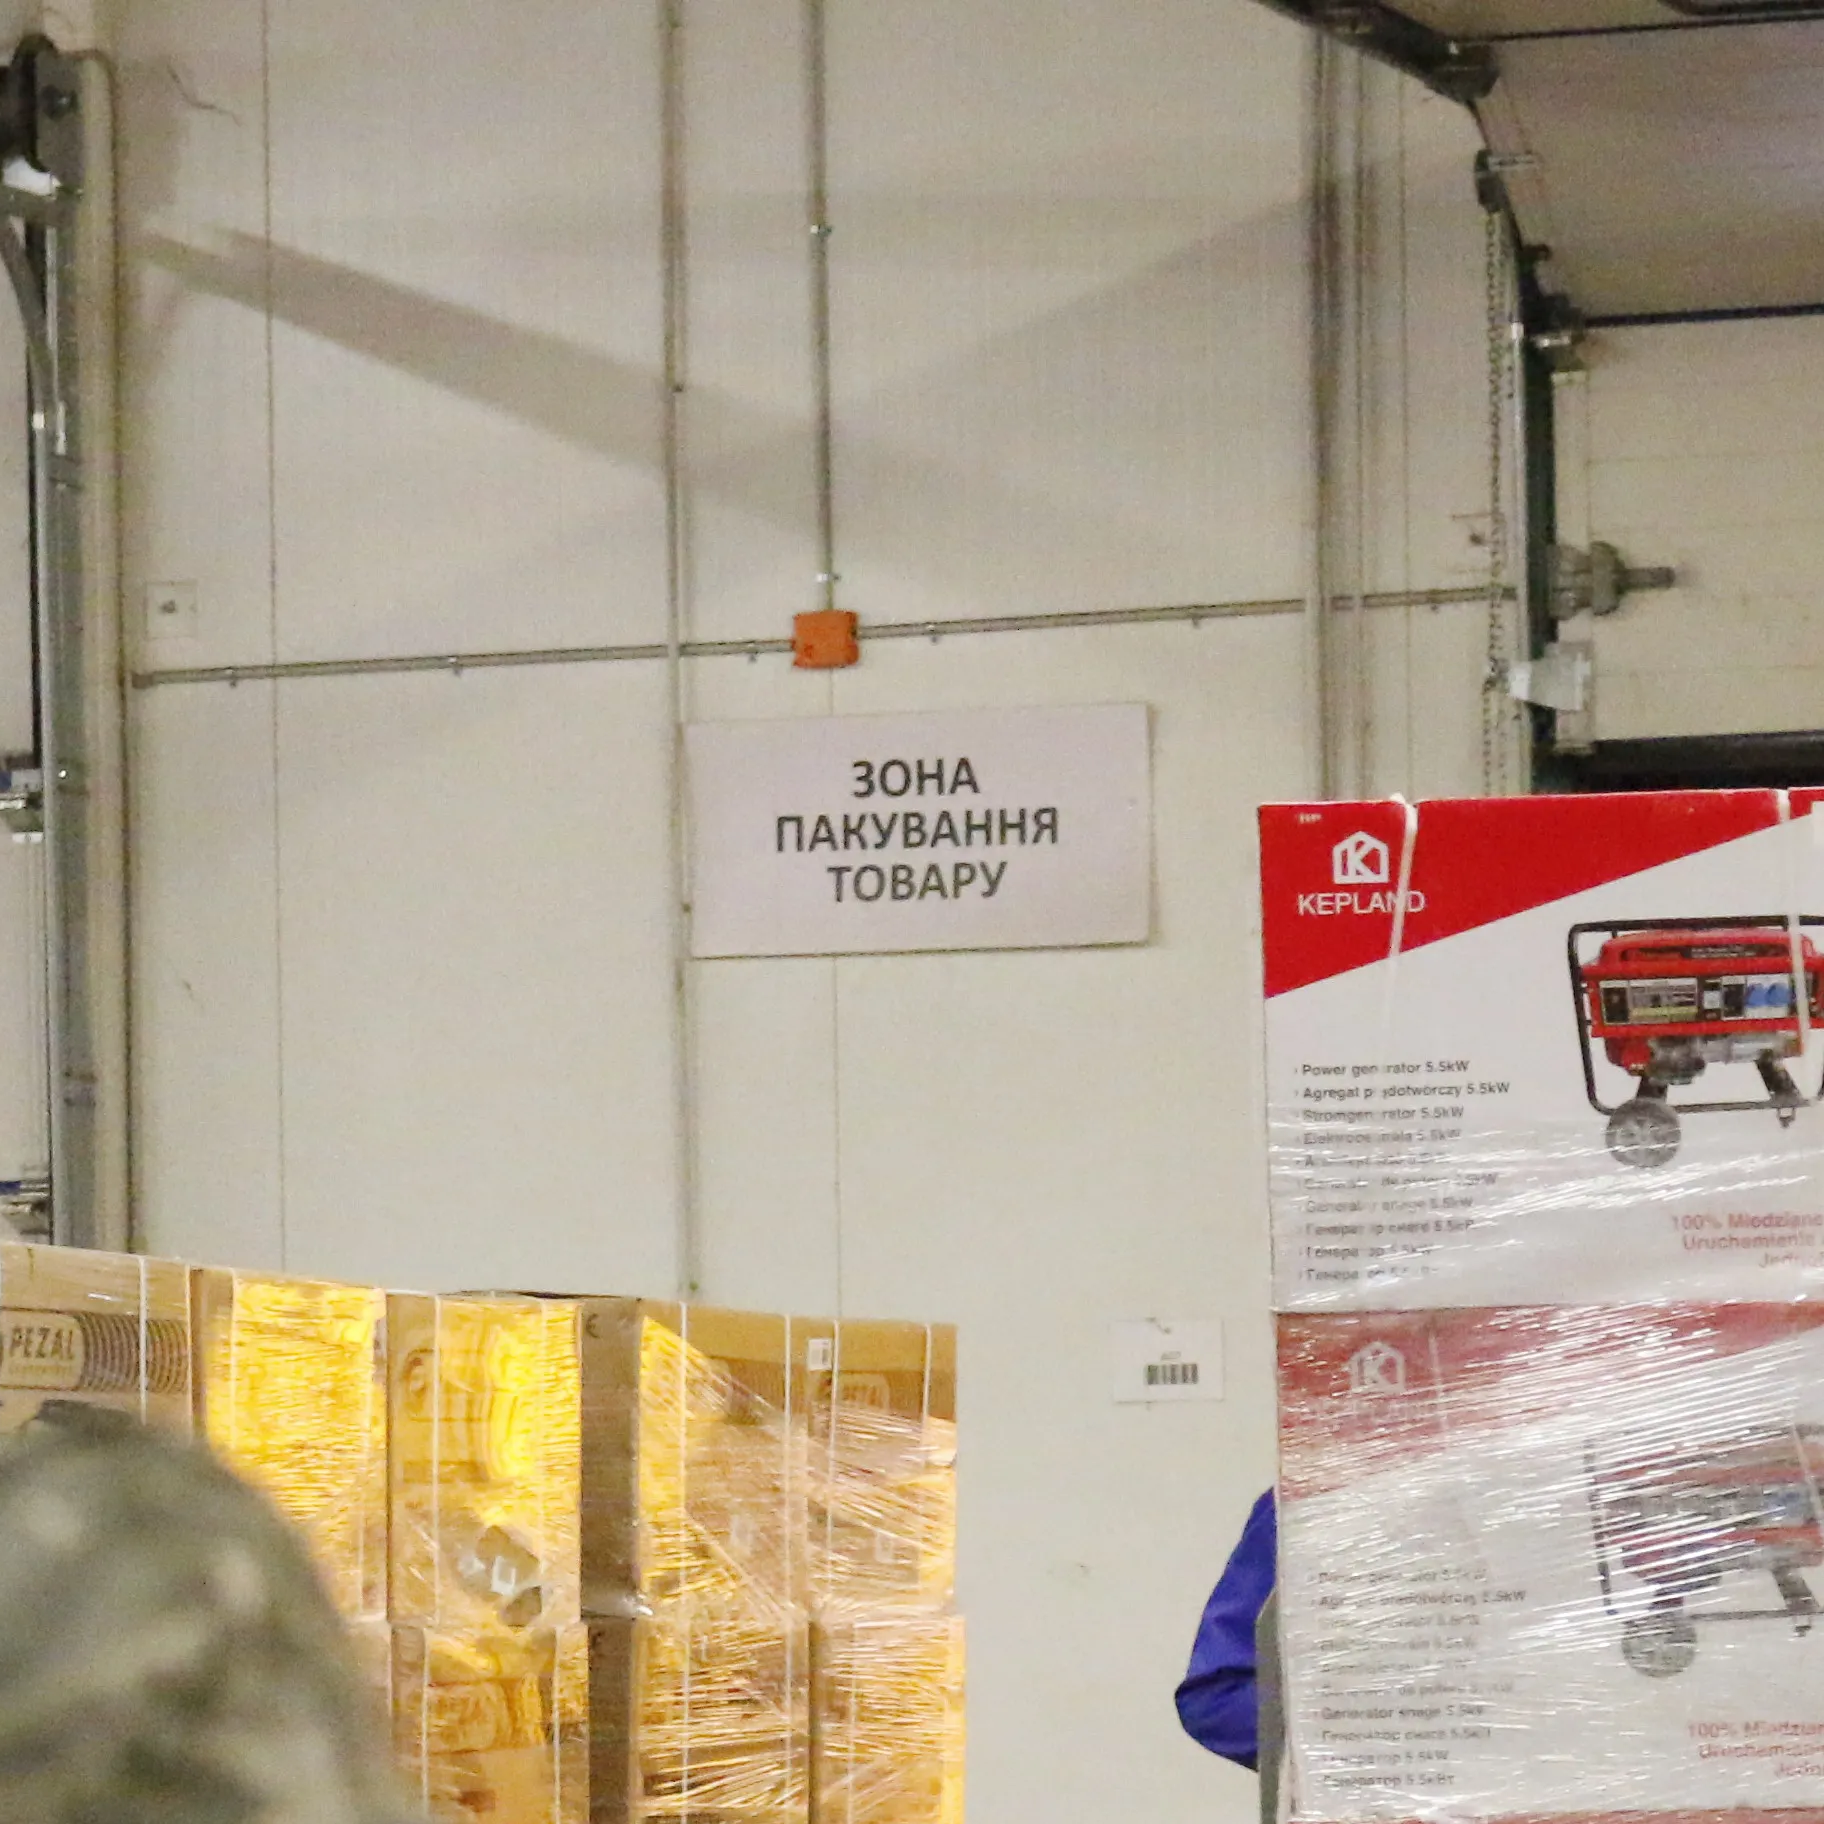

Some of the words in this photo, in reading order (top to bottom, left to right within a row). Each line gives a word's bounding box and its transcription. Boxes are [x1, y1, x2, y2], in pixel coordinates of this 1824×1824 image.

[853, 757, 980, 799] ЗОНА
[776, 807, 1059, 853] ПАКУВАННЯ
[826, 861, 1008, 902] ТОВАРУ
[1302, 1064, 1346, 1076] Power
[1352, 1062, 1421, 1078] genrator
[1425, 1060, 1470, 1073] 5.5kW
[1303, 1086, 1360, 1101] Agregat
[1302, 1106, 1416, 1123] Stromgenrator
[8, 1326, 75, 1360] PEZAL
